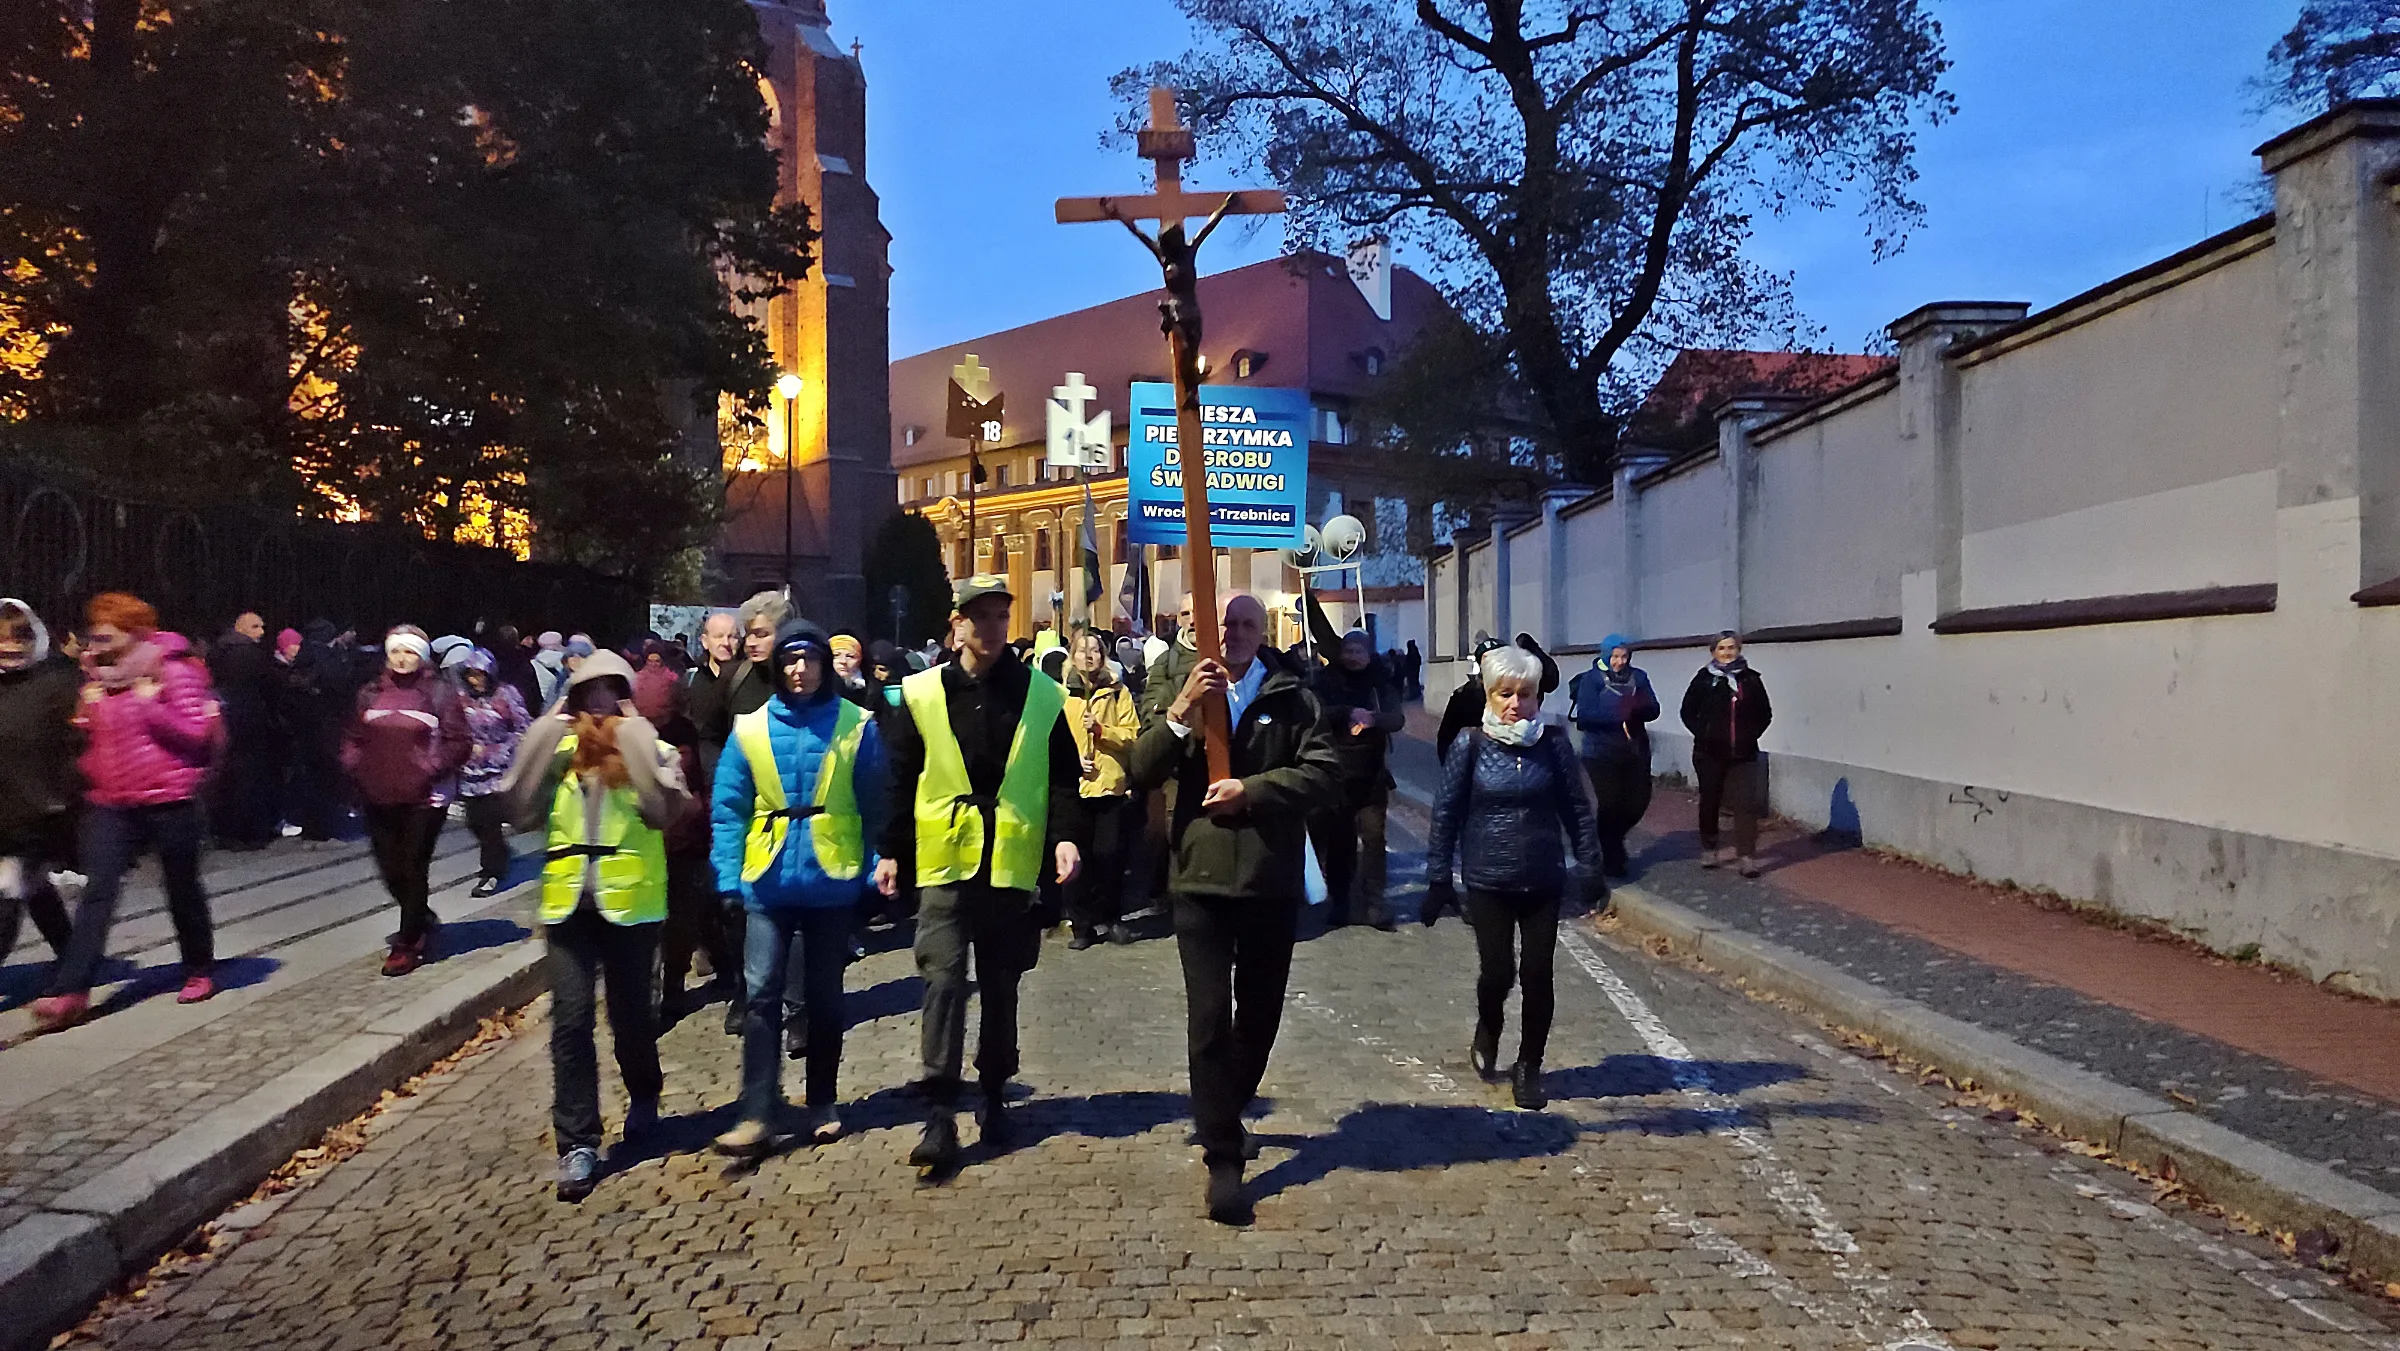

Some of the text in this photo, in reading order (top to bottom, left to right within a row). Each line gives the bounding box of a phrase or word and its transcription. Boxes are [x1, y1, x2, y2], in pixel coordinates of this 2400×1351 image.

[1198, 405, 1257, 424] IESZA
[980, 420, 1002, 442] 18
[1145, 425, 1293, 447] PIERZYMKA
[1203, 450, 1273, 469] GROBU
[1204, 472, 1285, 491] ADWIGI
